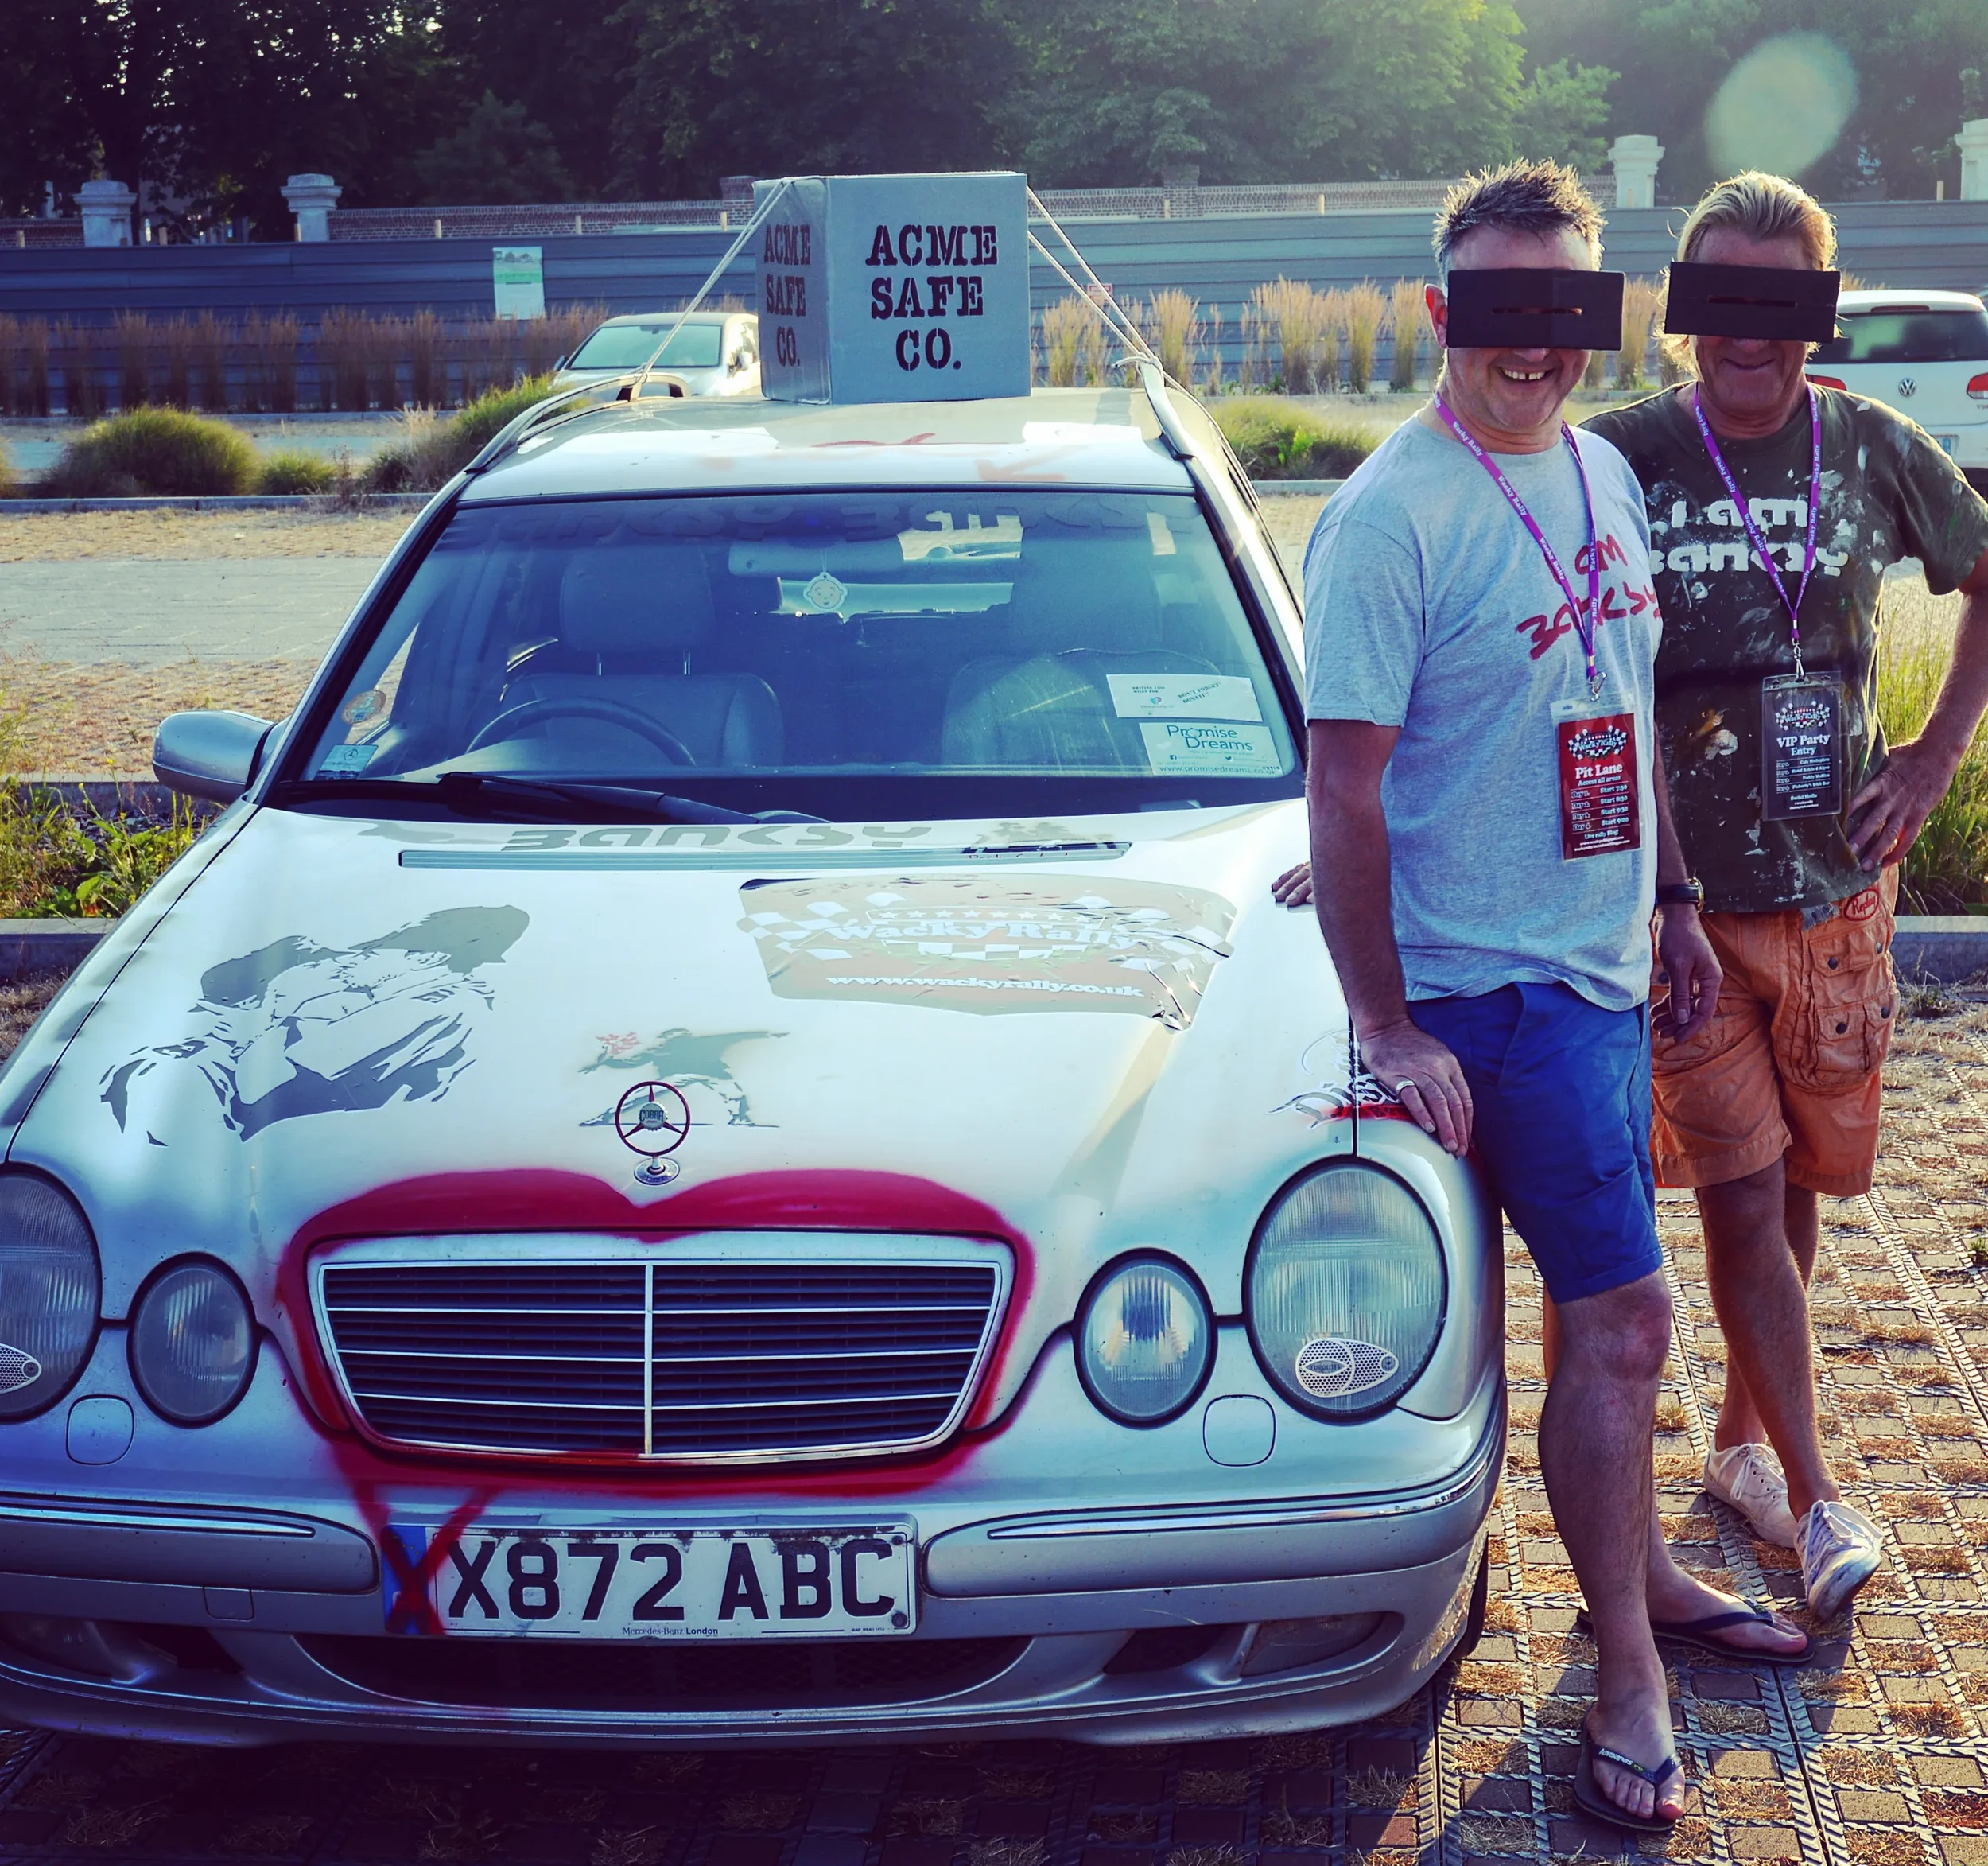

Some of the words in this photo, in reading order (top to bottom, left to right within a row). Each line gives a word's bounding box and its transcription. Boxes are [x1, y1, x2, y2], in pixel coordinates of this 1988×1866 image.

[763, 224, 810, 266] ACME
[865, 224, 997, 266] ACME
[766, 274, 806, 317] SAFE
[871, 276, 984, 320] SAFE
[776, 326, 800, 367] CO.
[896, 328, 961, 371] CO.
[1454, 421, 1469, 441] Wacky
[1468, 439, 1484, 457] Rally
[1715, 455, 1727, 475] Wacky
[1725, 476, 1736, 492] Rally
[1498, 475, 1514, 497] Wacky
[1512, 496, 1528, 515] Rally
[1672, 501, 1687, 528] I
[1745, 513, 1756, 535] Wacky
[1754, 534, 1765, 552] Rally
[1540, 537, 1554, 560] Wacky
[1553, 560, 1565, 580] Rally
[1167, 725, 1238, 738] Promise
[1186, 737, 1254, 751] Dreams
[1776, 736, 1797, 748] VIP
[1800, 734, 1831, 745] Party
[1791, 746, 1817, 756] Entry
[1575, 767, 1594, 779] Pit
[1595, 764, 1623, 776] Lane
[1852, 892, 1876, 916] Replay
[824, 921, 997, 940] Wacky
[826, 977, 1145, 997] www.wackyrally.co.uk
[446, 1538, 685, 1622] X872
[717, 1537, 896, 1621] ABC
[623, 1627, 683, 1635] Mercedes-Benz
